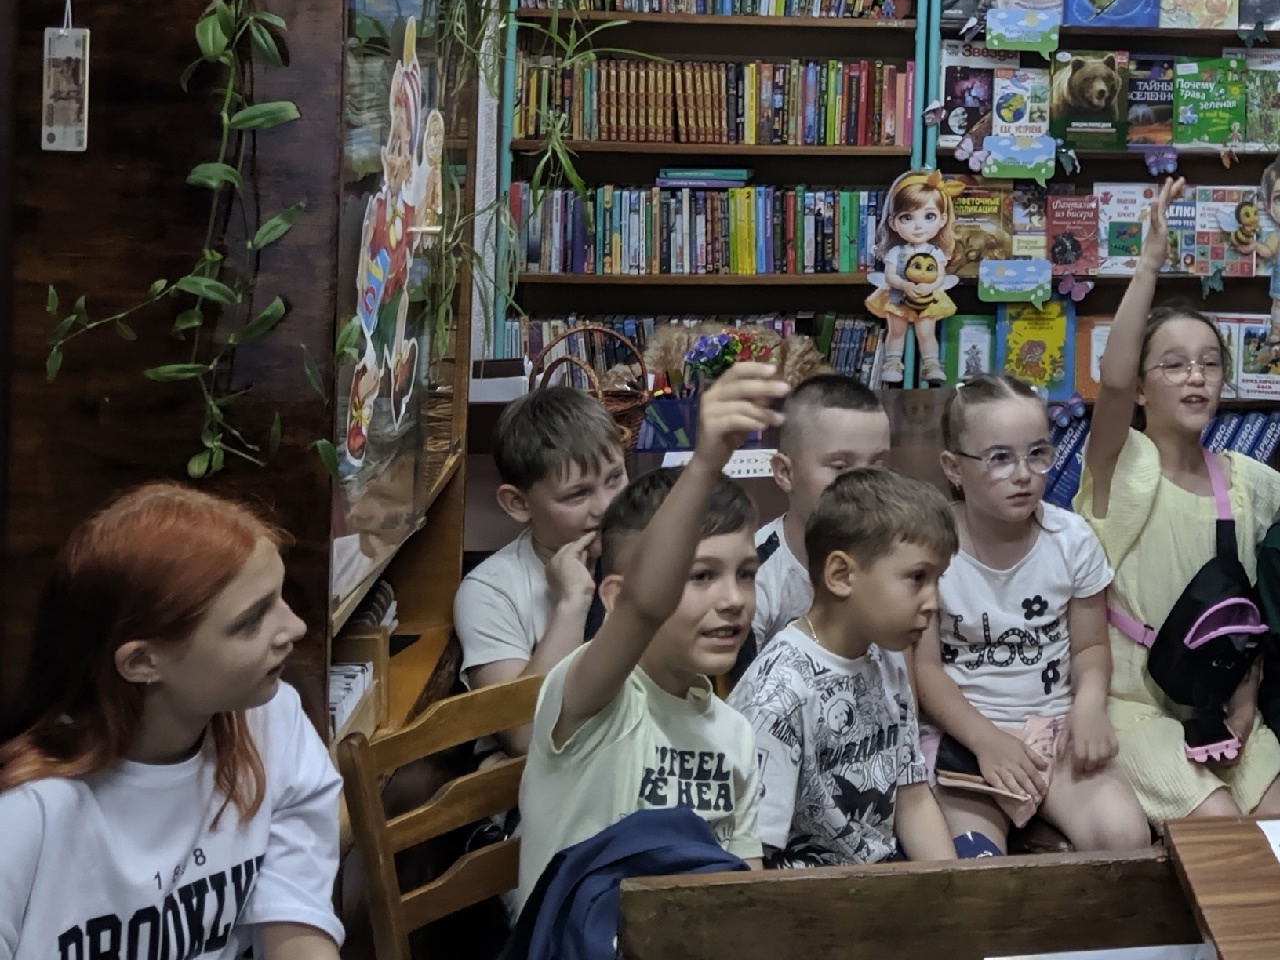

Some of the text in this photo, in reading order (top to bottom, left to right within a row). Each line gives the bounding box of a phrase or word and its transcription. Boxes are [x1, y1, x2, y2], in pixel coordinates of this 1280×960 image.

[1128, 91, 1173, 101] СЕЛЕНН
[1136, 80, 1173, 91] ТАЙНЫ
[1176, 78, 1216, 93] Почему
[1180, 88, 1206, 100] трава
[954, 205, 998, 214] ППЛИКАЦИИ
[1055, 427, 1074, 458] РЕВО
[1208, 424, 1226, 453] РЕВО
[1216, 416, 1238, 454] ЗНАНИЯ
[1234, 423, 1251, 452] РЕВО
[1241, 415, 1264, 453] ЗНАНИЯ
[1254, 422, 1276, 460] ДРЕВО
[678, 780, 734, 812] HEA
[193, 848, 206, 866] 8
